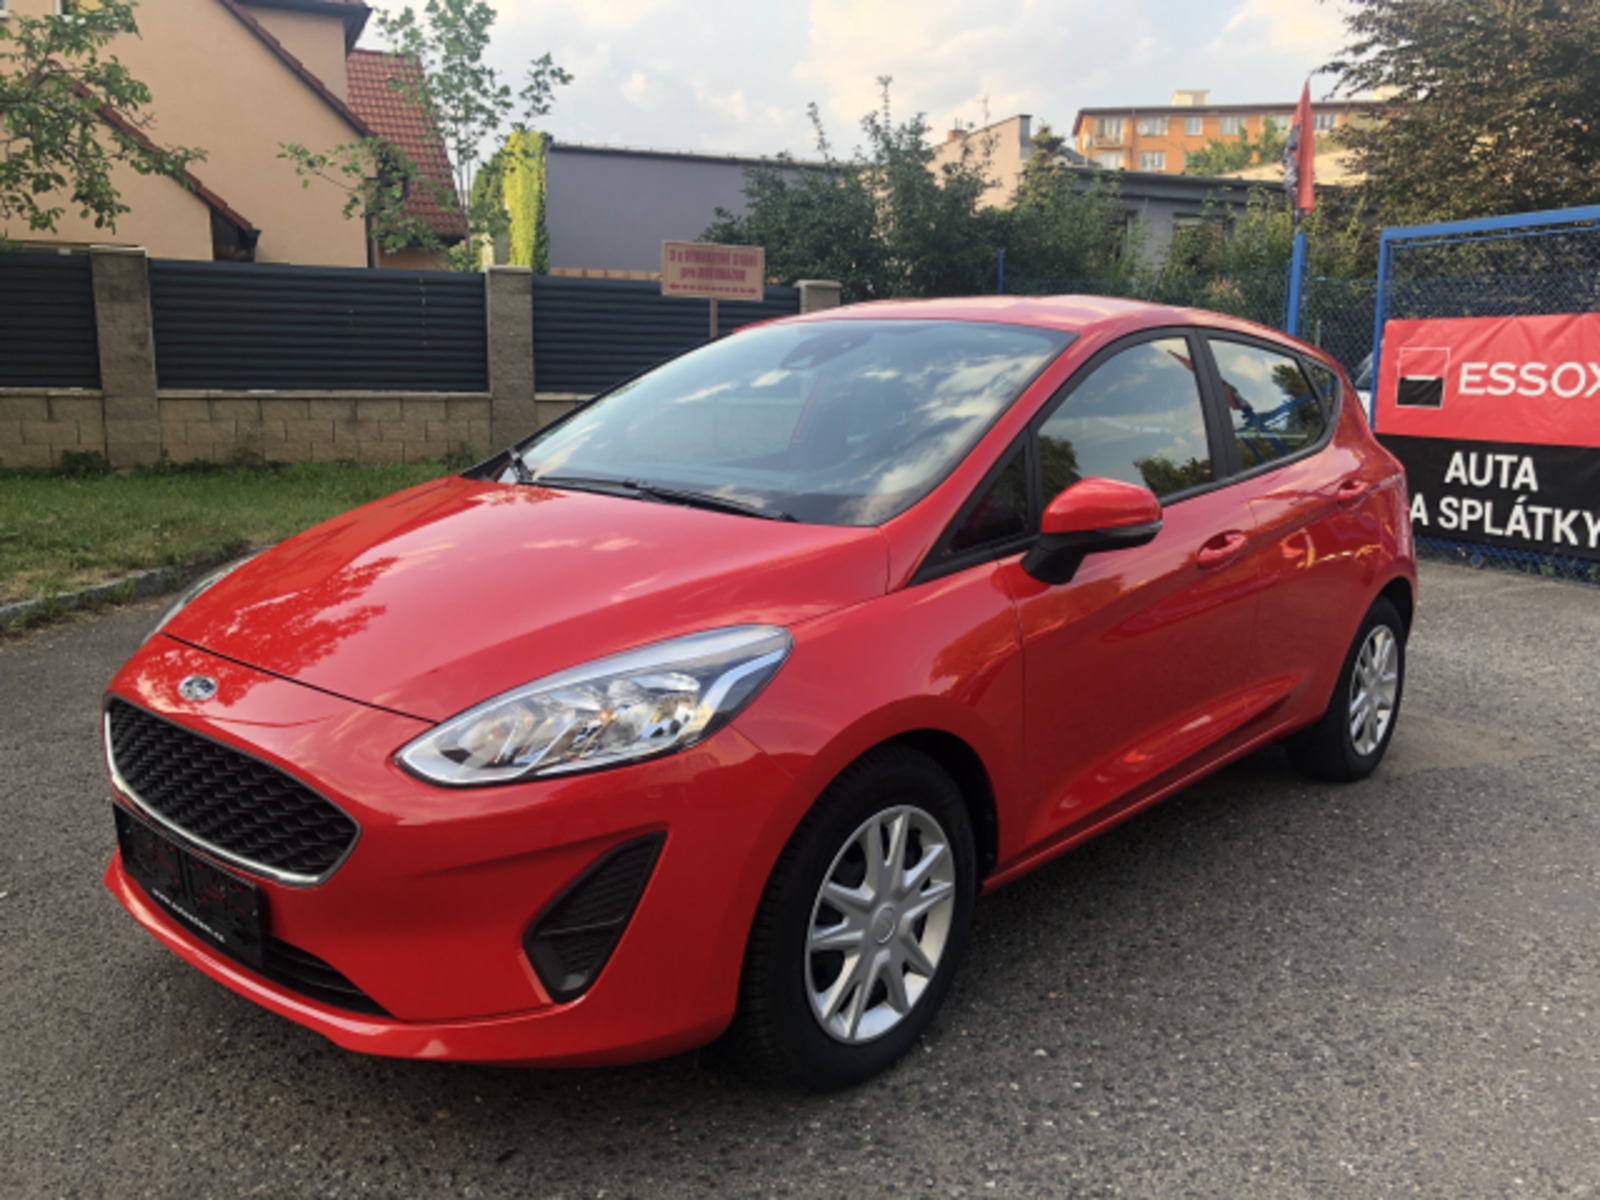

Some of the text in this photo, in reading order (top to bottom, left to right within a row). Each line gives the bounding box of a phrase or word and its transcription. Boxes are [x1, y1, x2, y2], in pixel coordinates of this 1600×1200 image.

[1458, 361, 1600, 398] ESSOX
[1444, 451, 1538, 492] AUTA
[1437, 495, 1600, 548] SPLÁTKY
